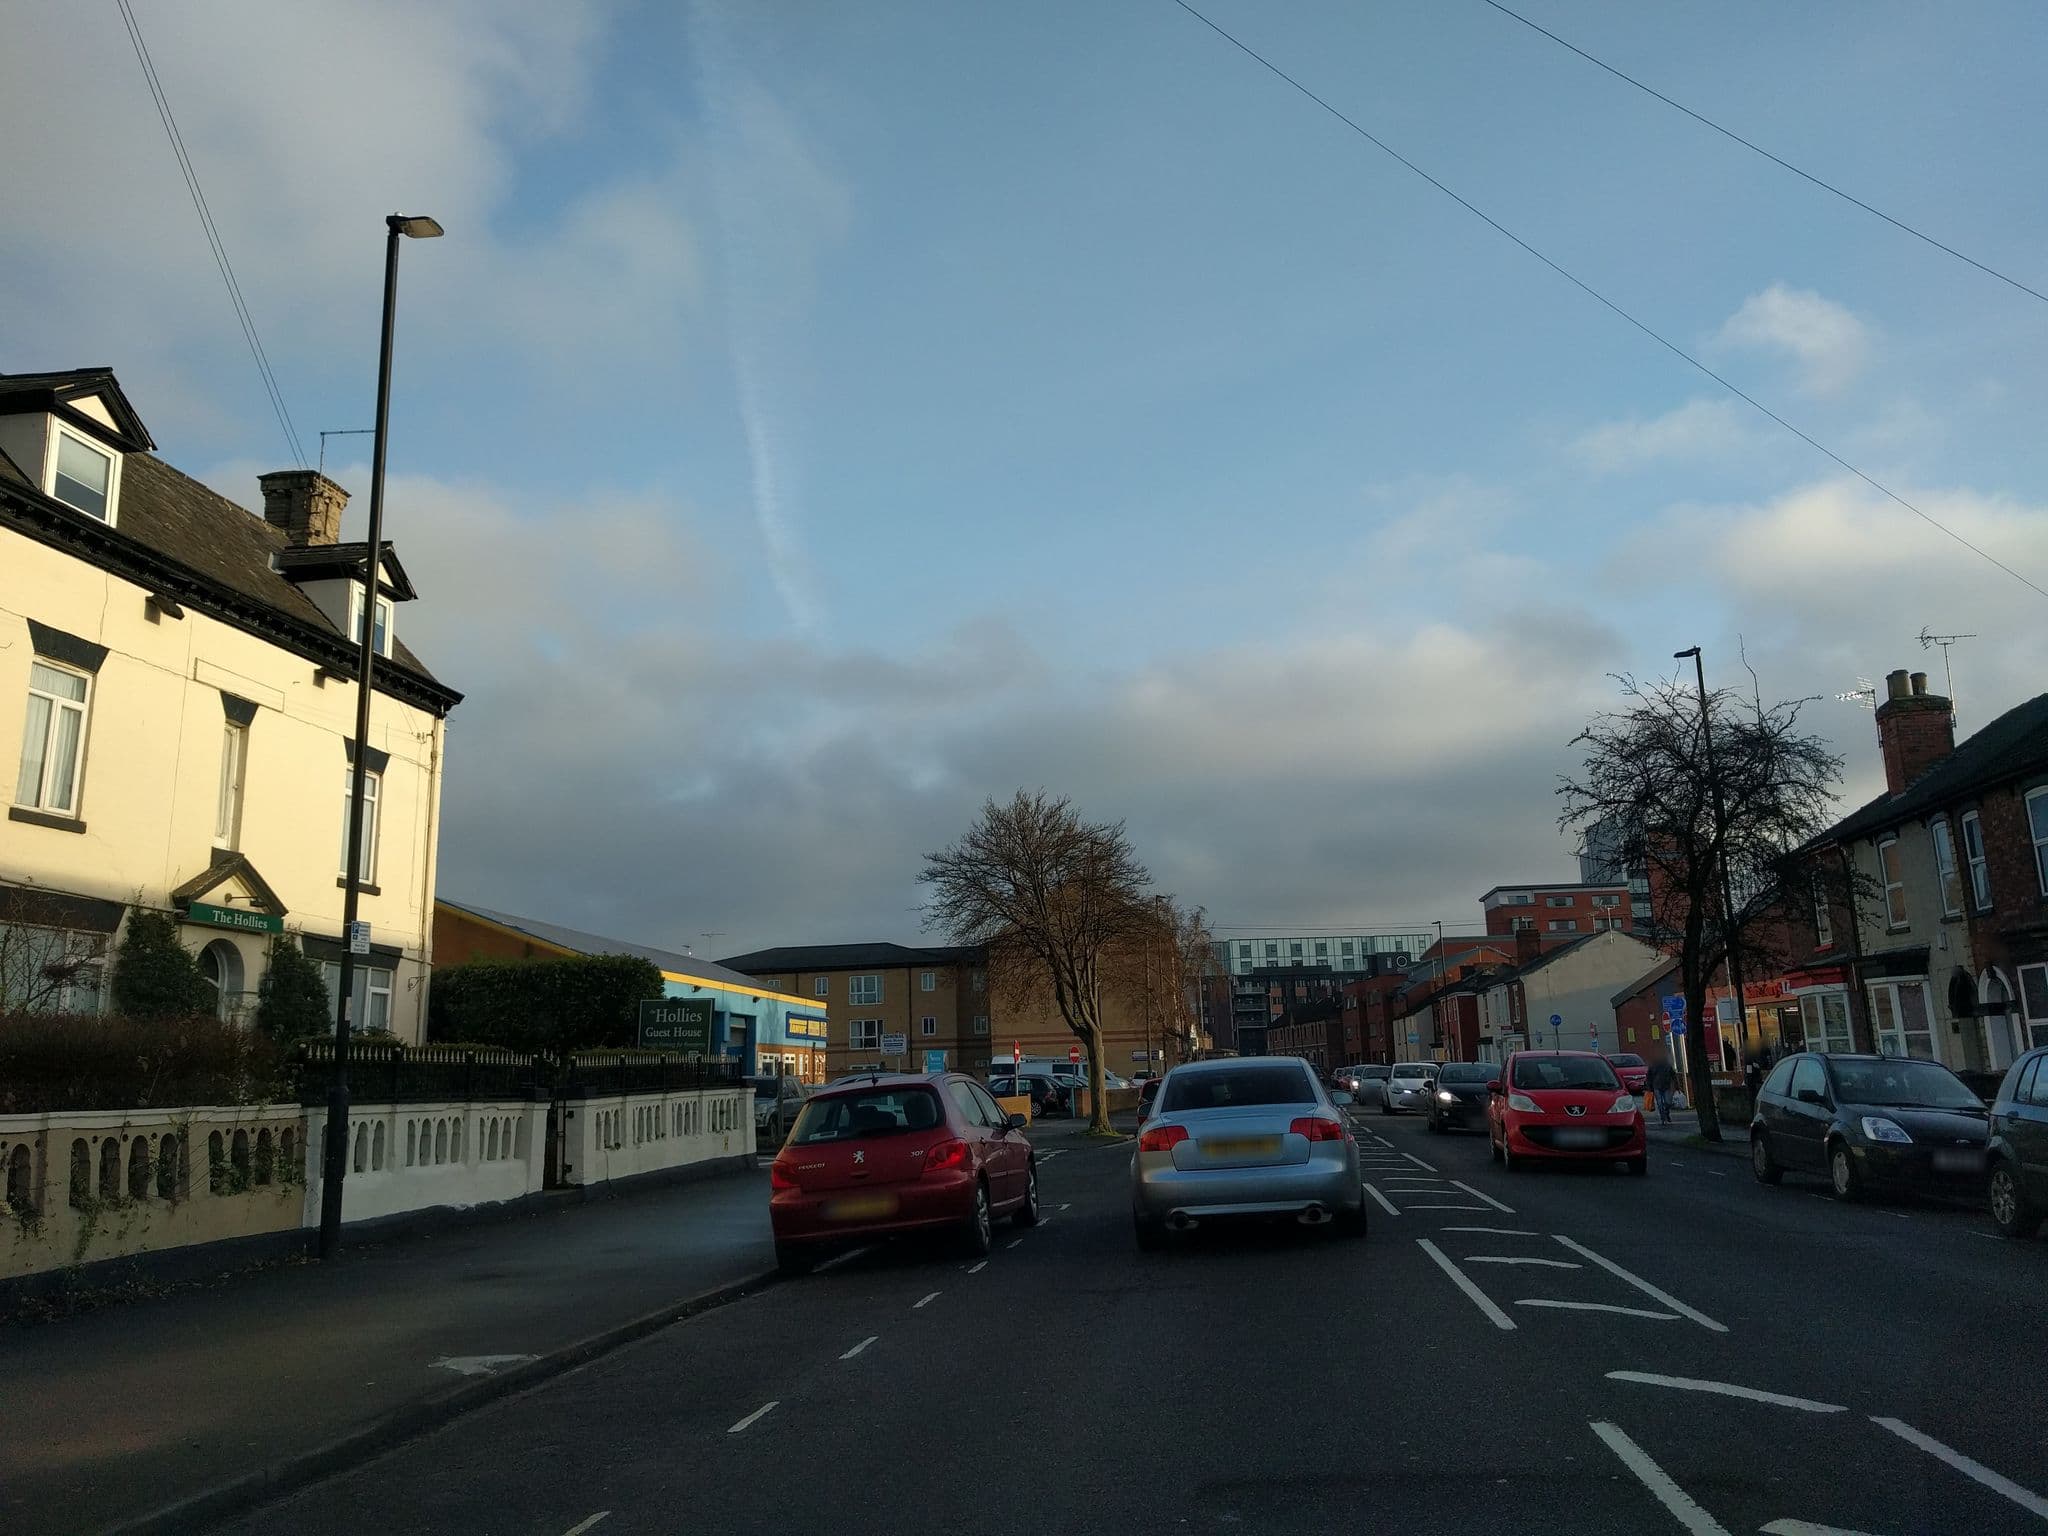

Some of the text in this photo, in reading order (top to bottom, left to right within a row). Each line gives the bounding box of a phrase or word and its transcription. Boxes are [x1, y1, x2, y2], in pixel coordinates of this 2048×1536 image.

[212, 910, 268, 929] The Hollies
[655, 1008, 703, 1023] Hollies
[645, 1026, 702, 1037] Guest House
